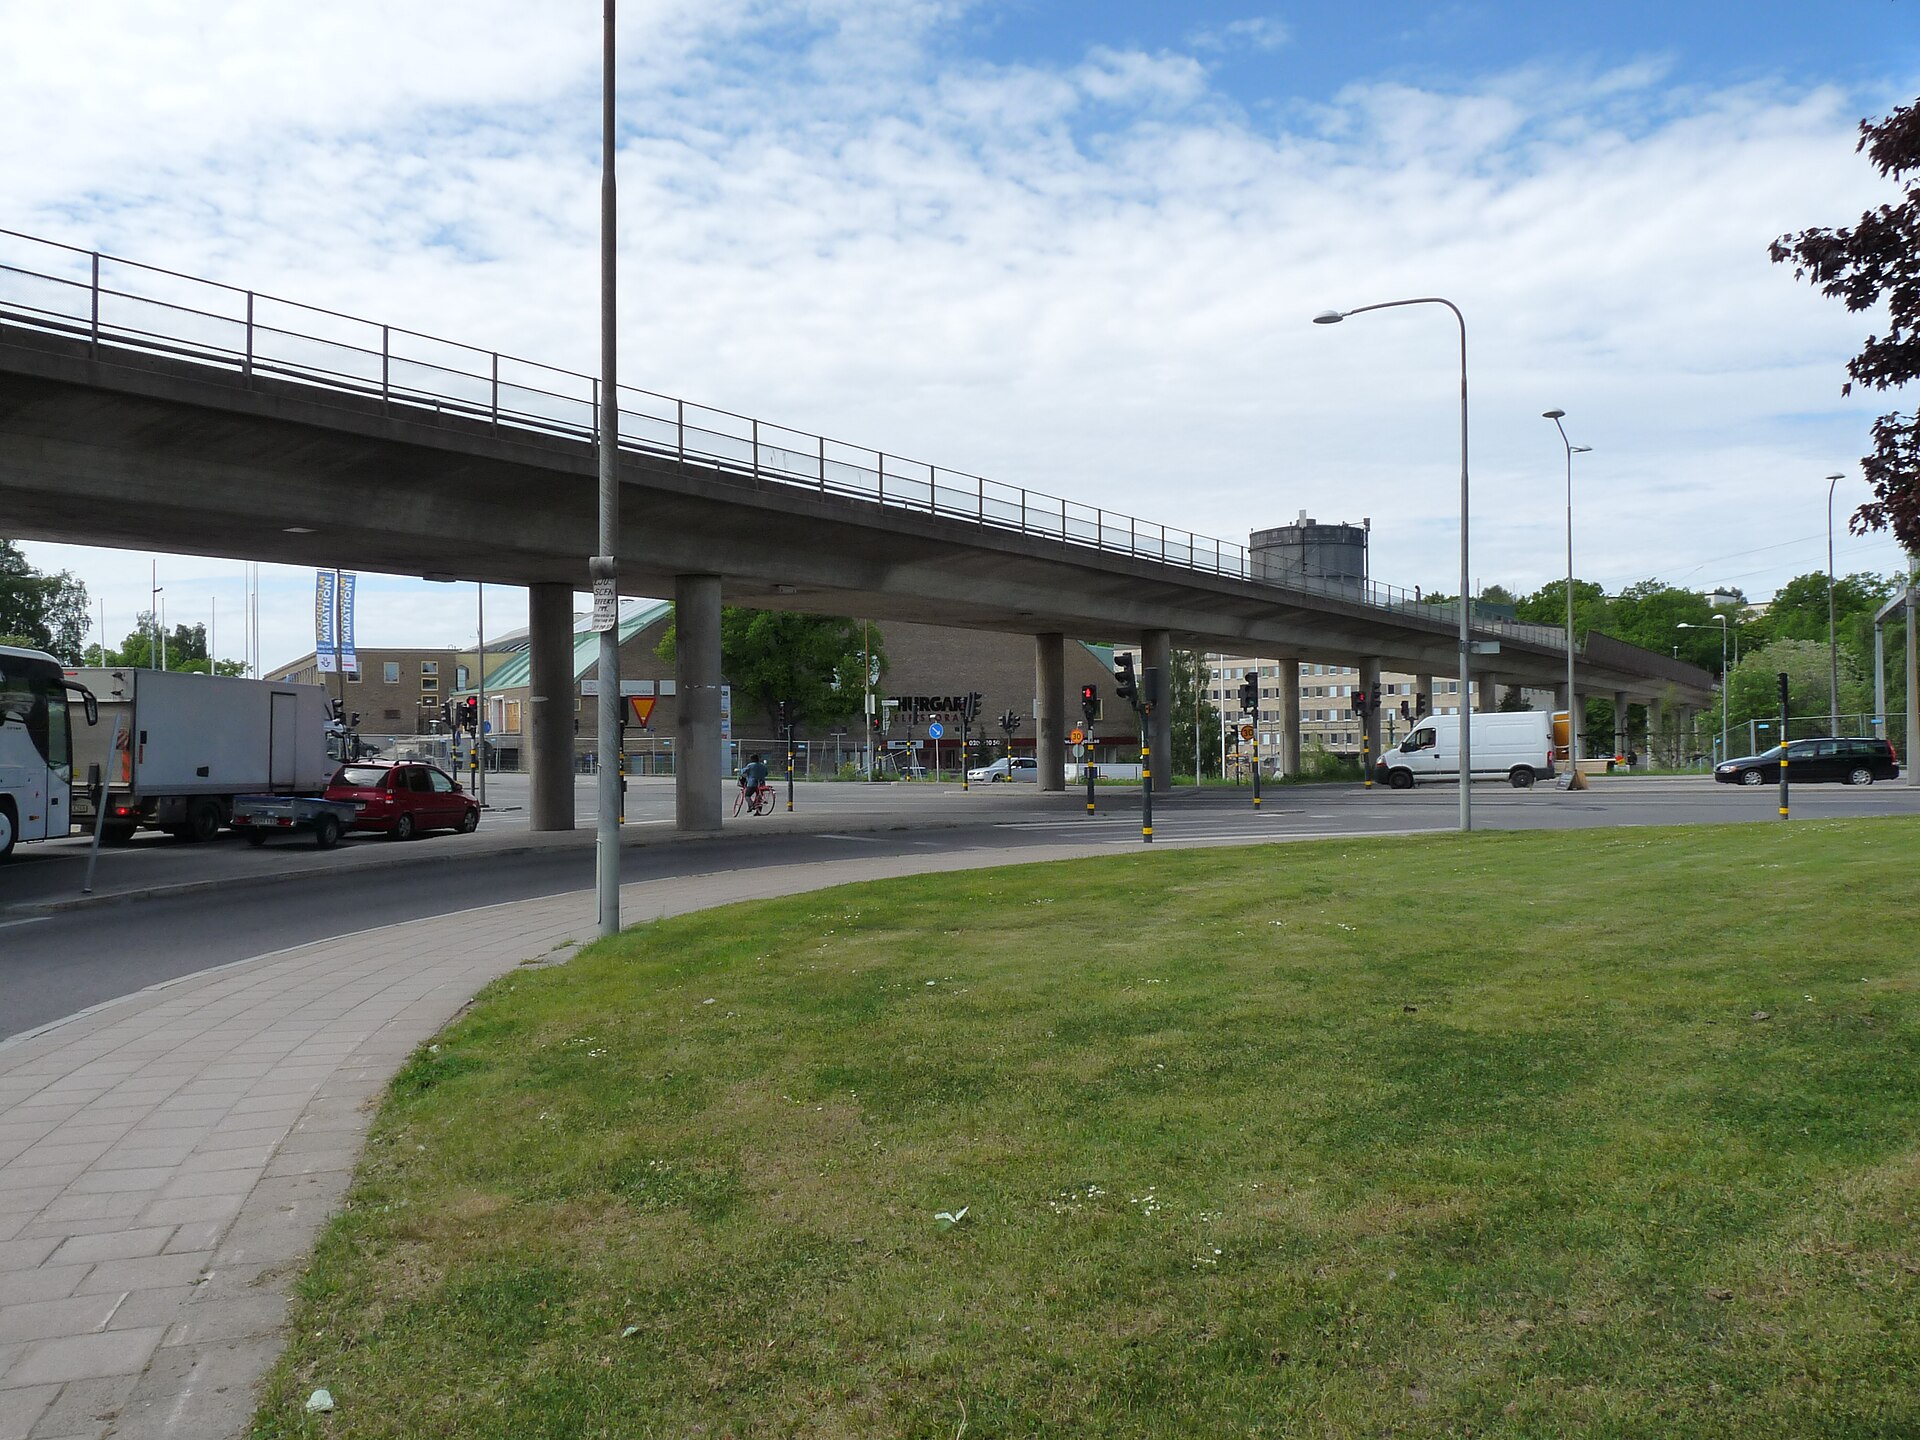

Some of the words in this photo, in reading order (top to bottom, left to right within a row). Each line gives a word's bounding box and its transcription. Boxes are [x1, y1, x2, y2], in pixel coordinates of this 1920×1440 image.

[316, 575, 326, 641] STOCKHOLM
[322, 580, 332, 642] MARATHON
[343, 581, 353, 643] MARATHON
[889, 696, 969, 711] HURGAR
[1072, 732, 1081, 740] 30
